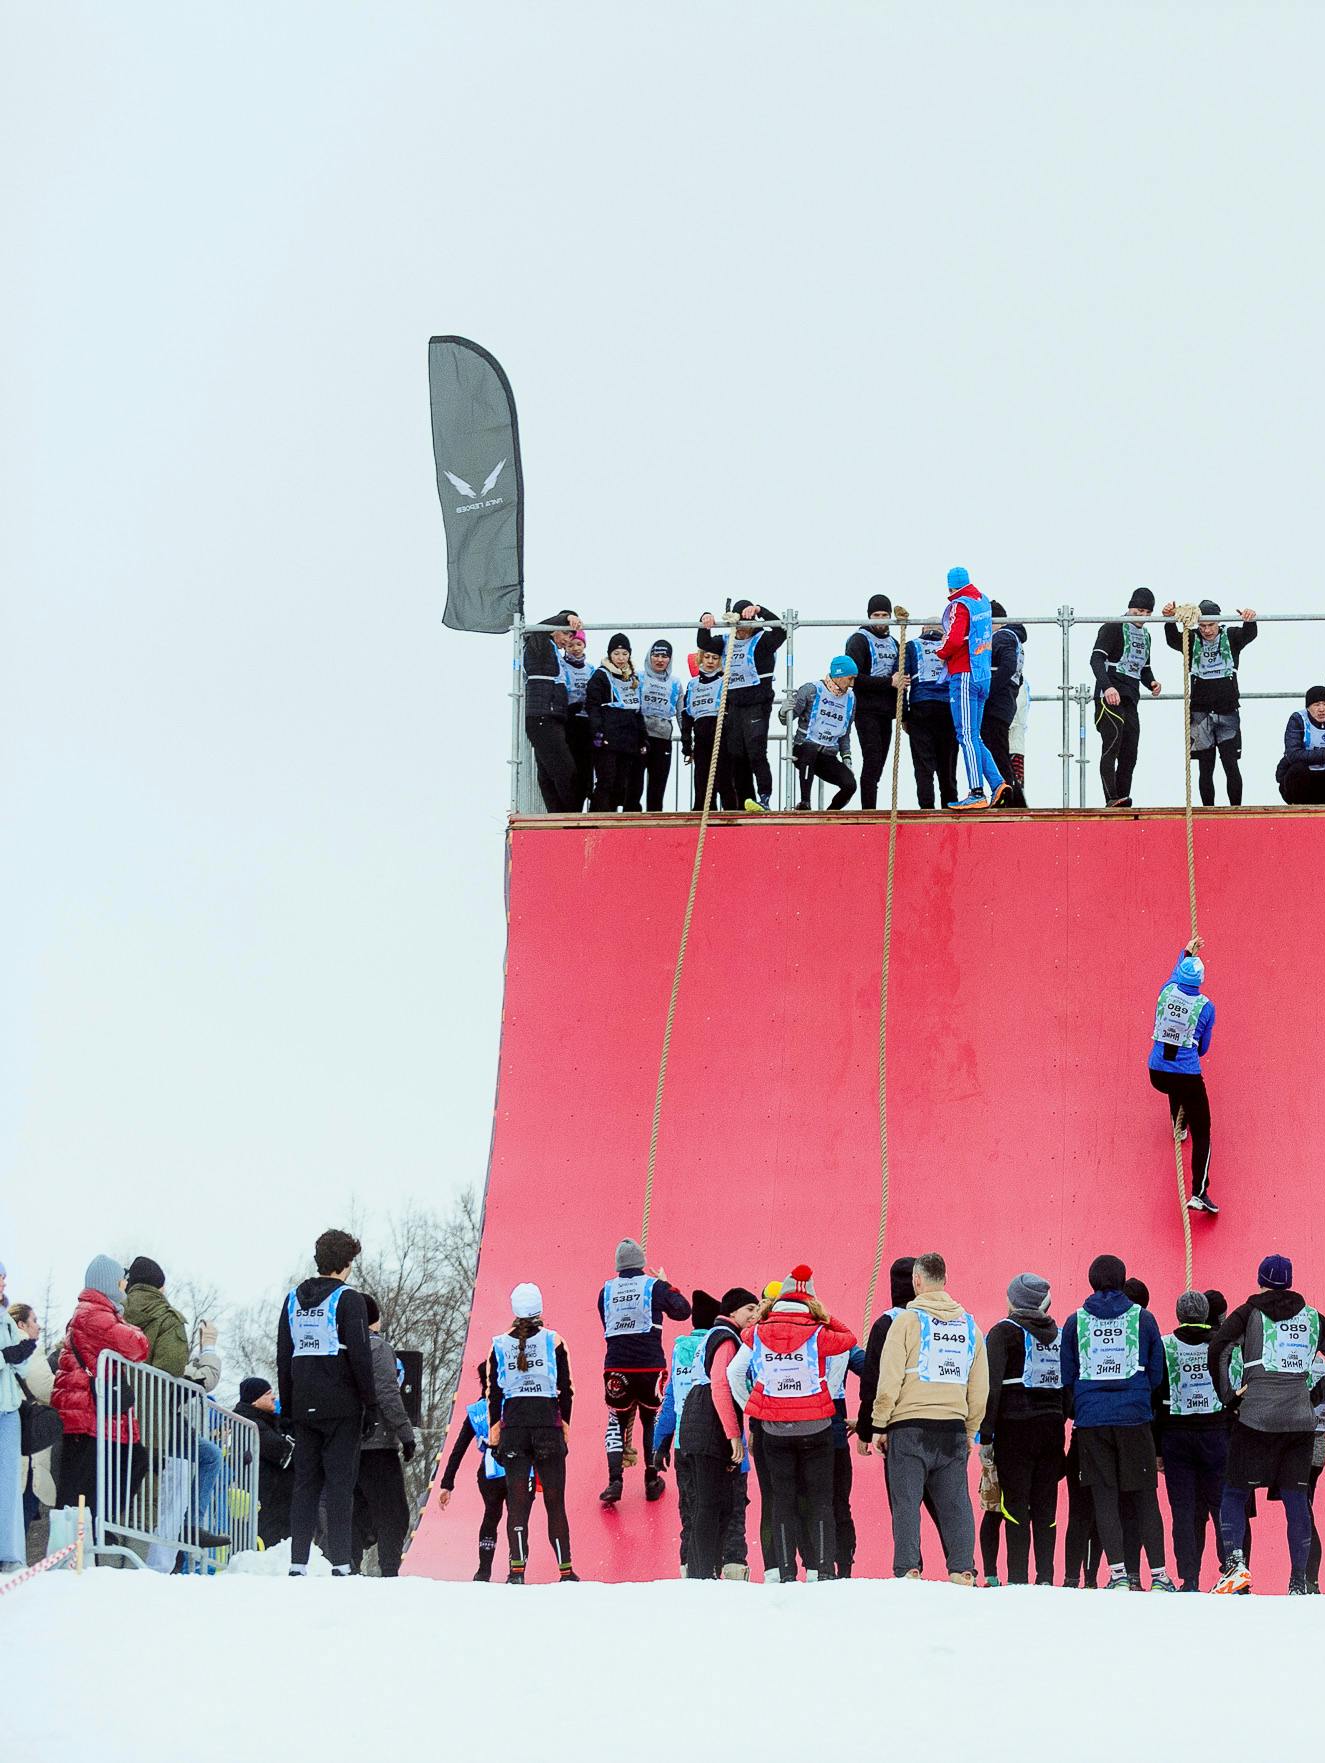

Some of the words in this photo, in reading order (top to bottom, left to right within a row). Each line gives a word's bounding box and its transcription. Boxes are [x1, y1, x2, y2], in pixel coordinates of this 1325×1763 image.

[644, 694, 669, 706] 5377
[820, 709, 844, 722] 5448
[612, 1294, 640, 1303] 5387
[296, 1309, 324, 1317] 5355
[1093, 1328, 1122, 1337] 089
[1280, 1323, 1307, 1332] 089
[933, 1332, 966, 1343] 5449
[299, 1339, 320, 1350] ЗИМА
[765, 1353, 804, 1362] 5446
[508, 1359, 544, 1370] 586
[1281, 1358, 1303, 1369] ЗИМА
[938, 1365, 960, 1377] ЗИМА
[1096, 1364, 1120, 1375] ЗИМА
[777, 1381, 802, 1391] ЗИМА
[1186, 1397, 1209, 1408] ЗИМА
